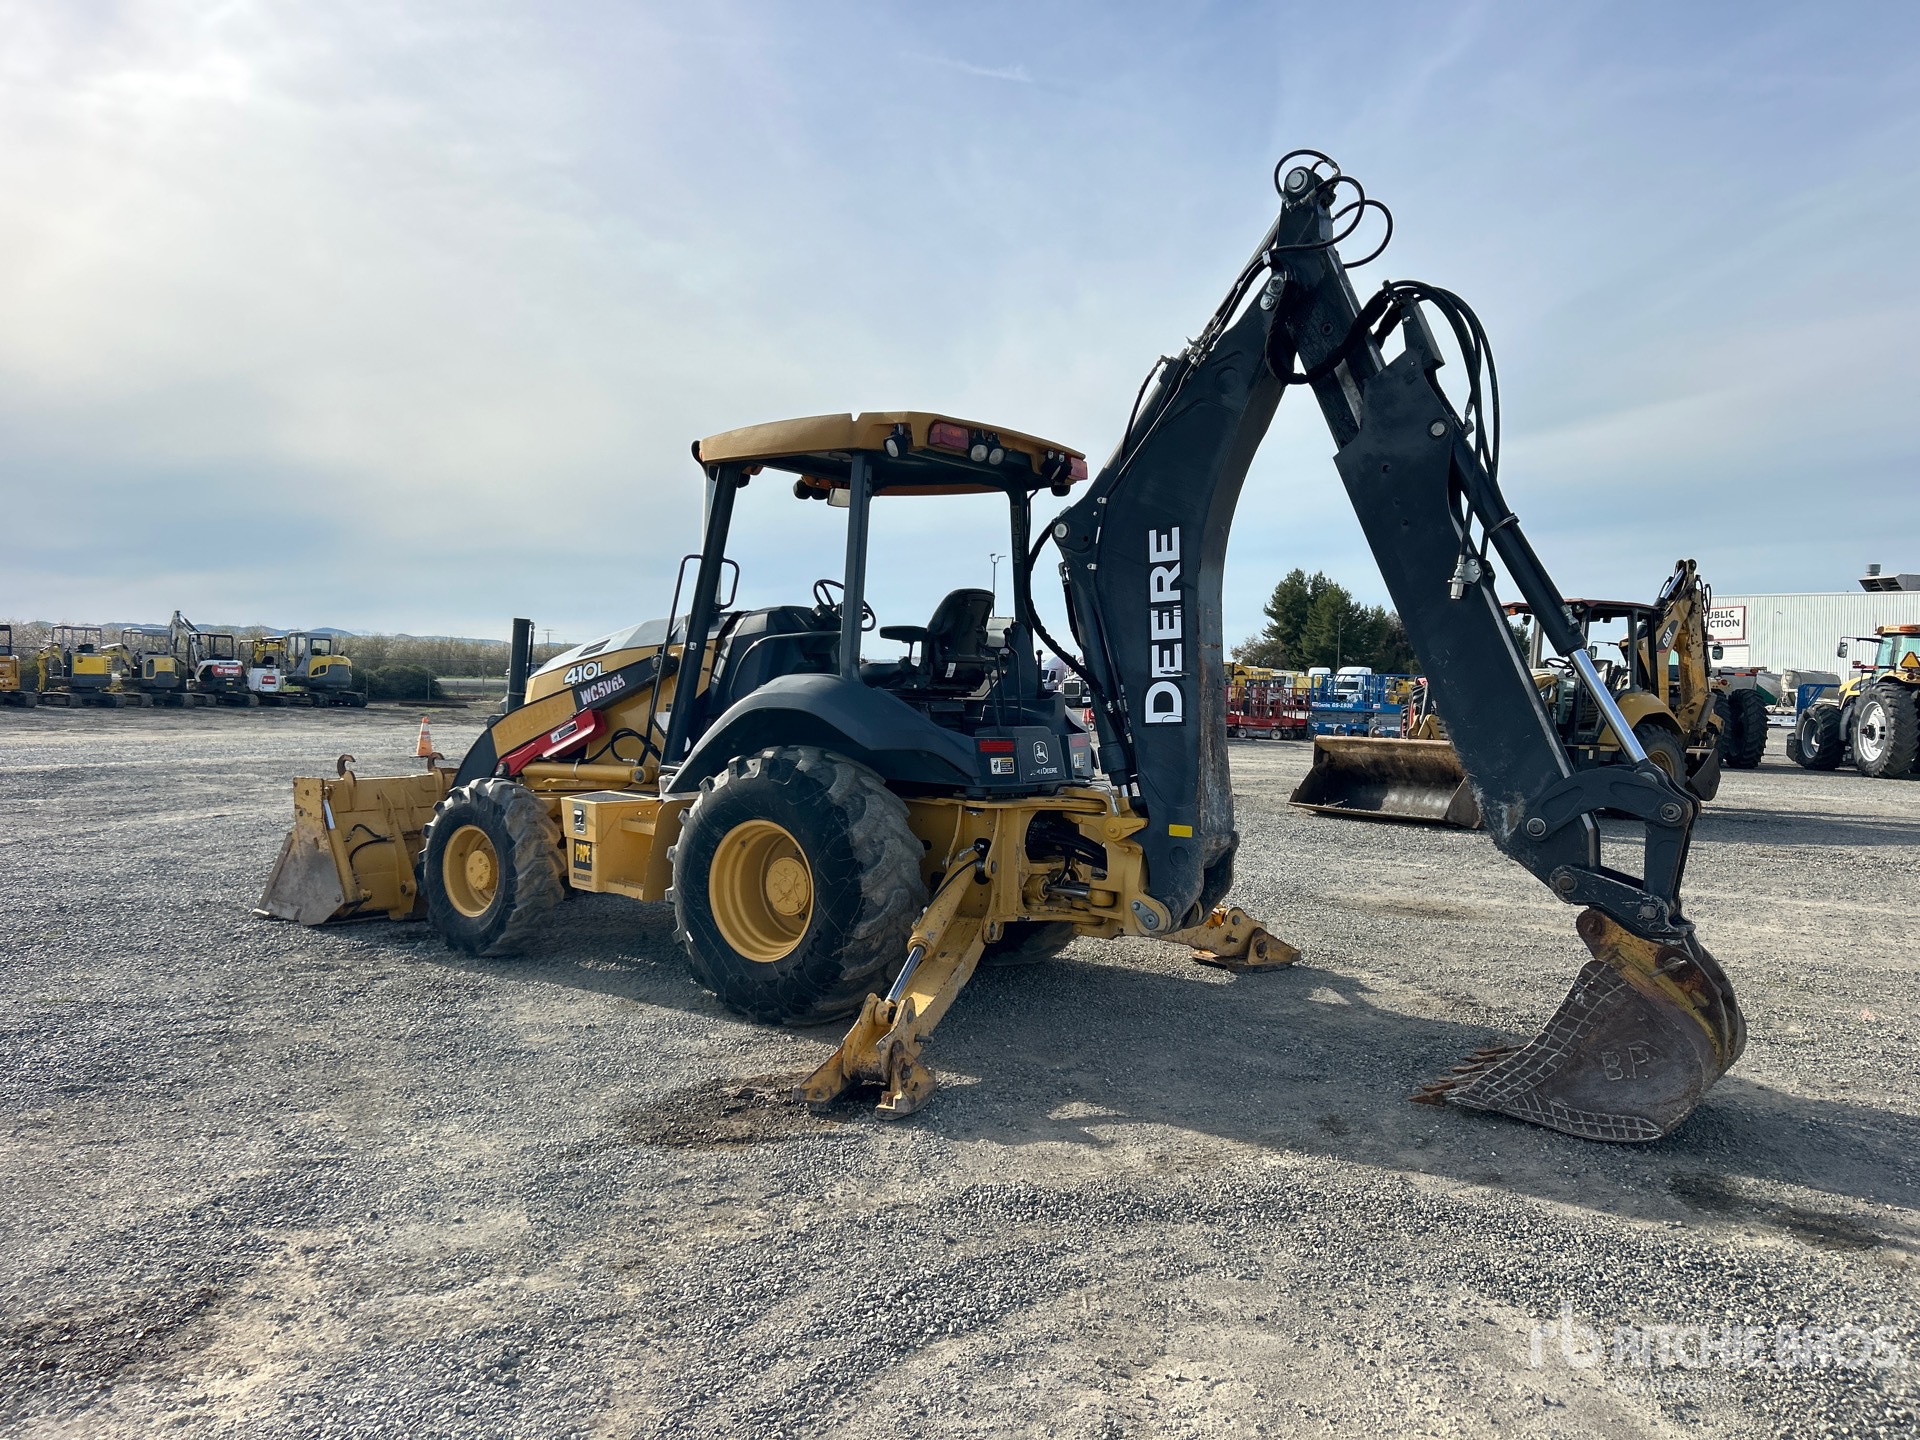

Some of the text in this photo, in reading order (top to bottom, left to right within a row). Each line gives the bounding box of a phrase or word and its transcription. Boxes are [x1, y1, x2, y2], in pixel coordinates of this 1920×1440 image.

[1146, 527, 1183, 723] DEERE
[1662, 627, 1673, 648] CAT
[563, 661, 607, 685] 410L
[580, 674, 626, 705] WC5V65
